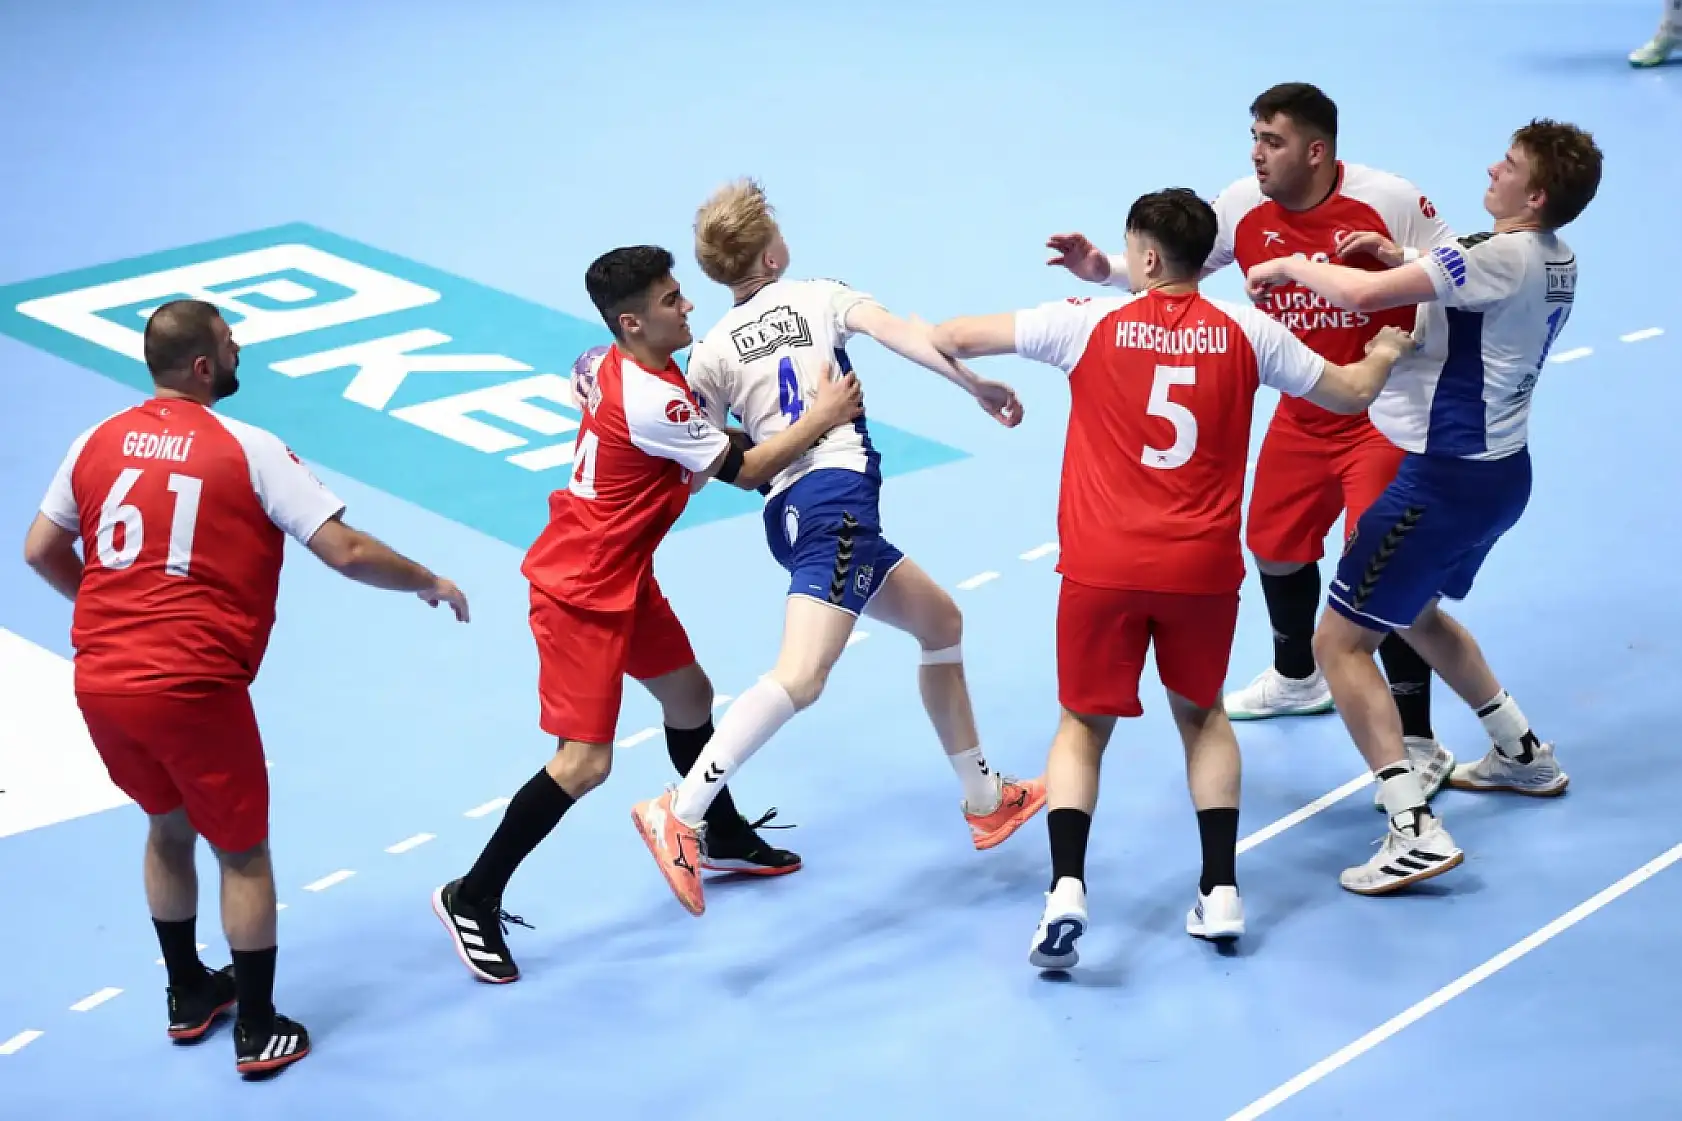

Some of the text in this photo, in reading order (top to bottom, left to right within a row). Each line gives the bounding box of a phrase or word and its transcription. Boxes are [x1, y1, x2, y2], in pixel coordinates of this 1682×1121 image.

[1267, 311, 1371, 330] IRLINES
[777, 355, 805, 425] 4
[1140, 363, 1199, 470] 5
[121, 430, 196, 462] GEDİKLİ
[95, 468, 204, 578] 61
